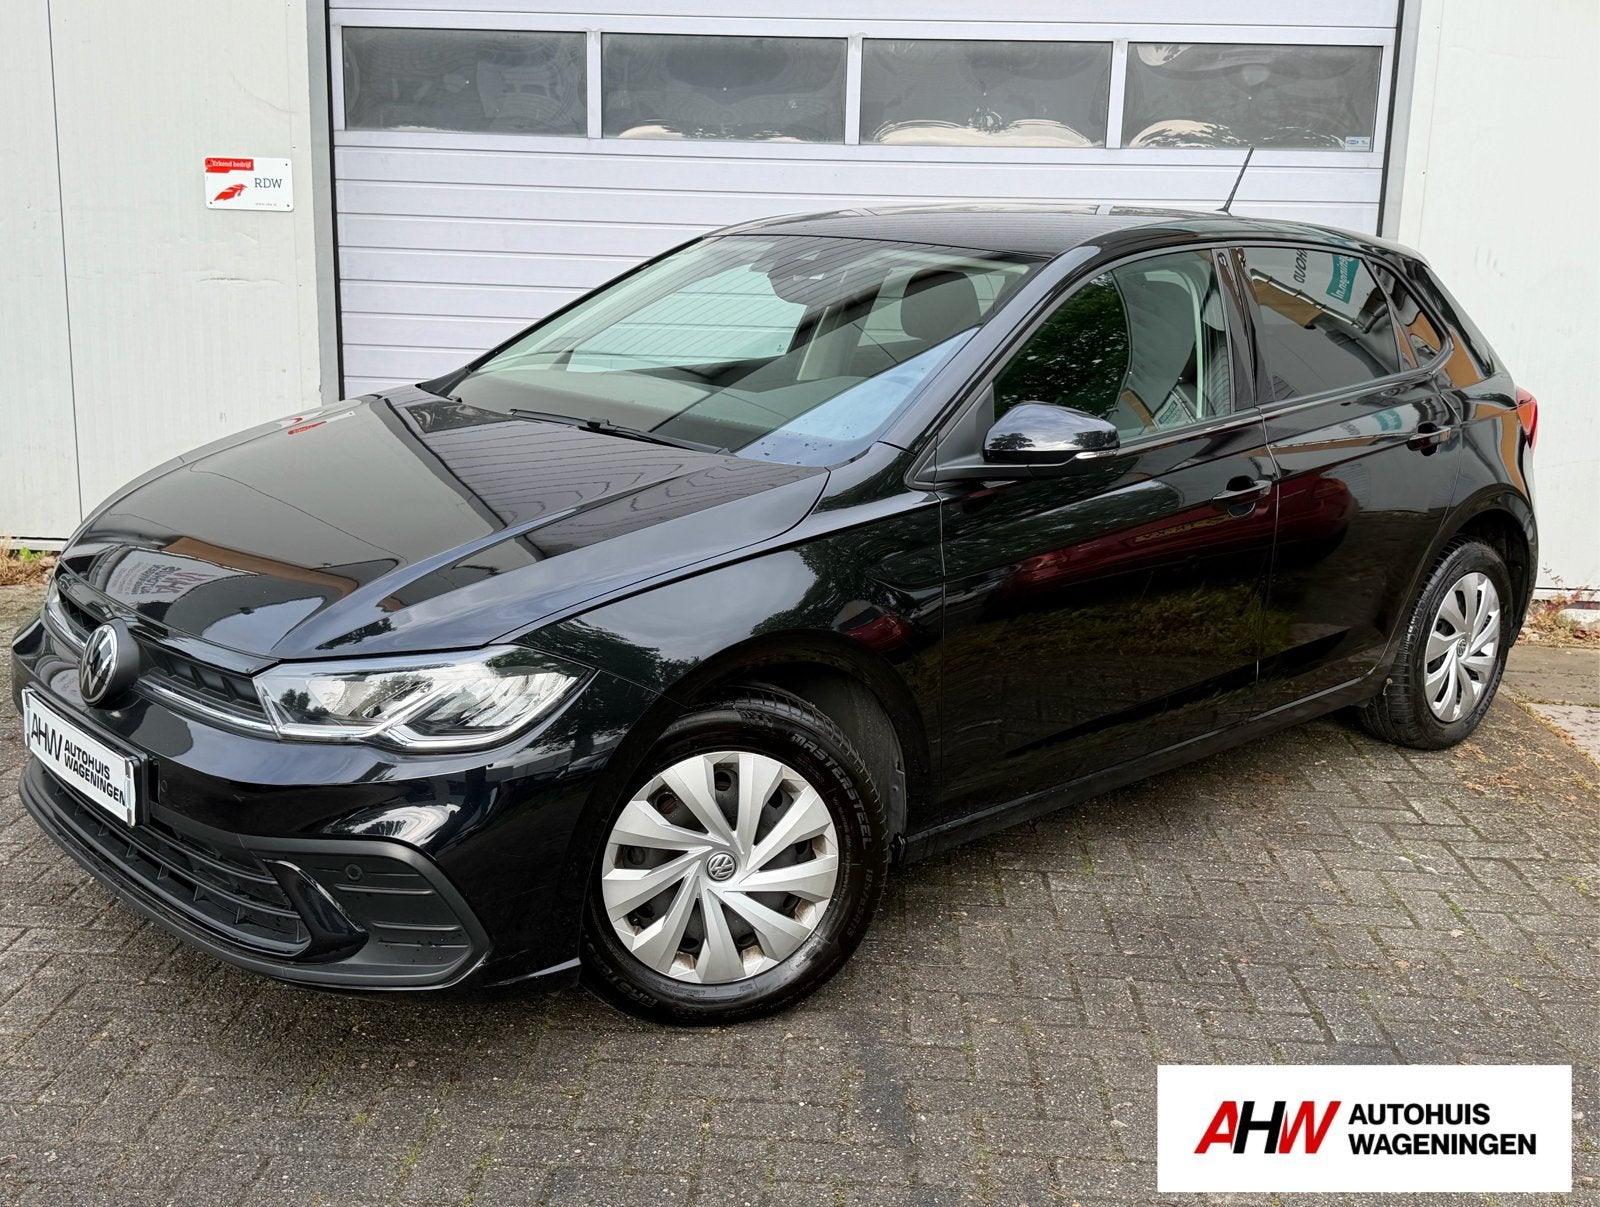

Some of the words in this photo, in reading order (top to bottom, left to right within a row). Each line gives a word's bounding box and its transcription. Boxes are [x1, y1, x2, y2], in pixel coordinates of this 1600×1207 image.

[254, 177, 283, 189] RDW
[31, 713, 63, 762] AHW
[64, 740, 110, 780] AUTOHUIS
[64, 753, 126, 807] WAGENINGEN
[791, 733, 872, 850] MASTERSTEEL
